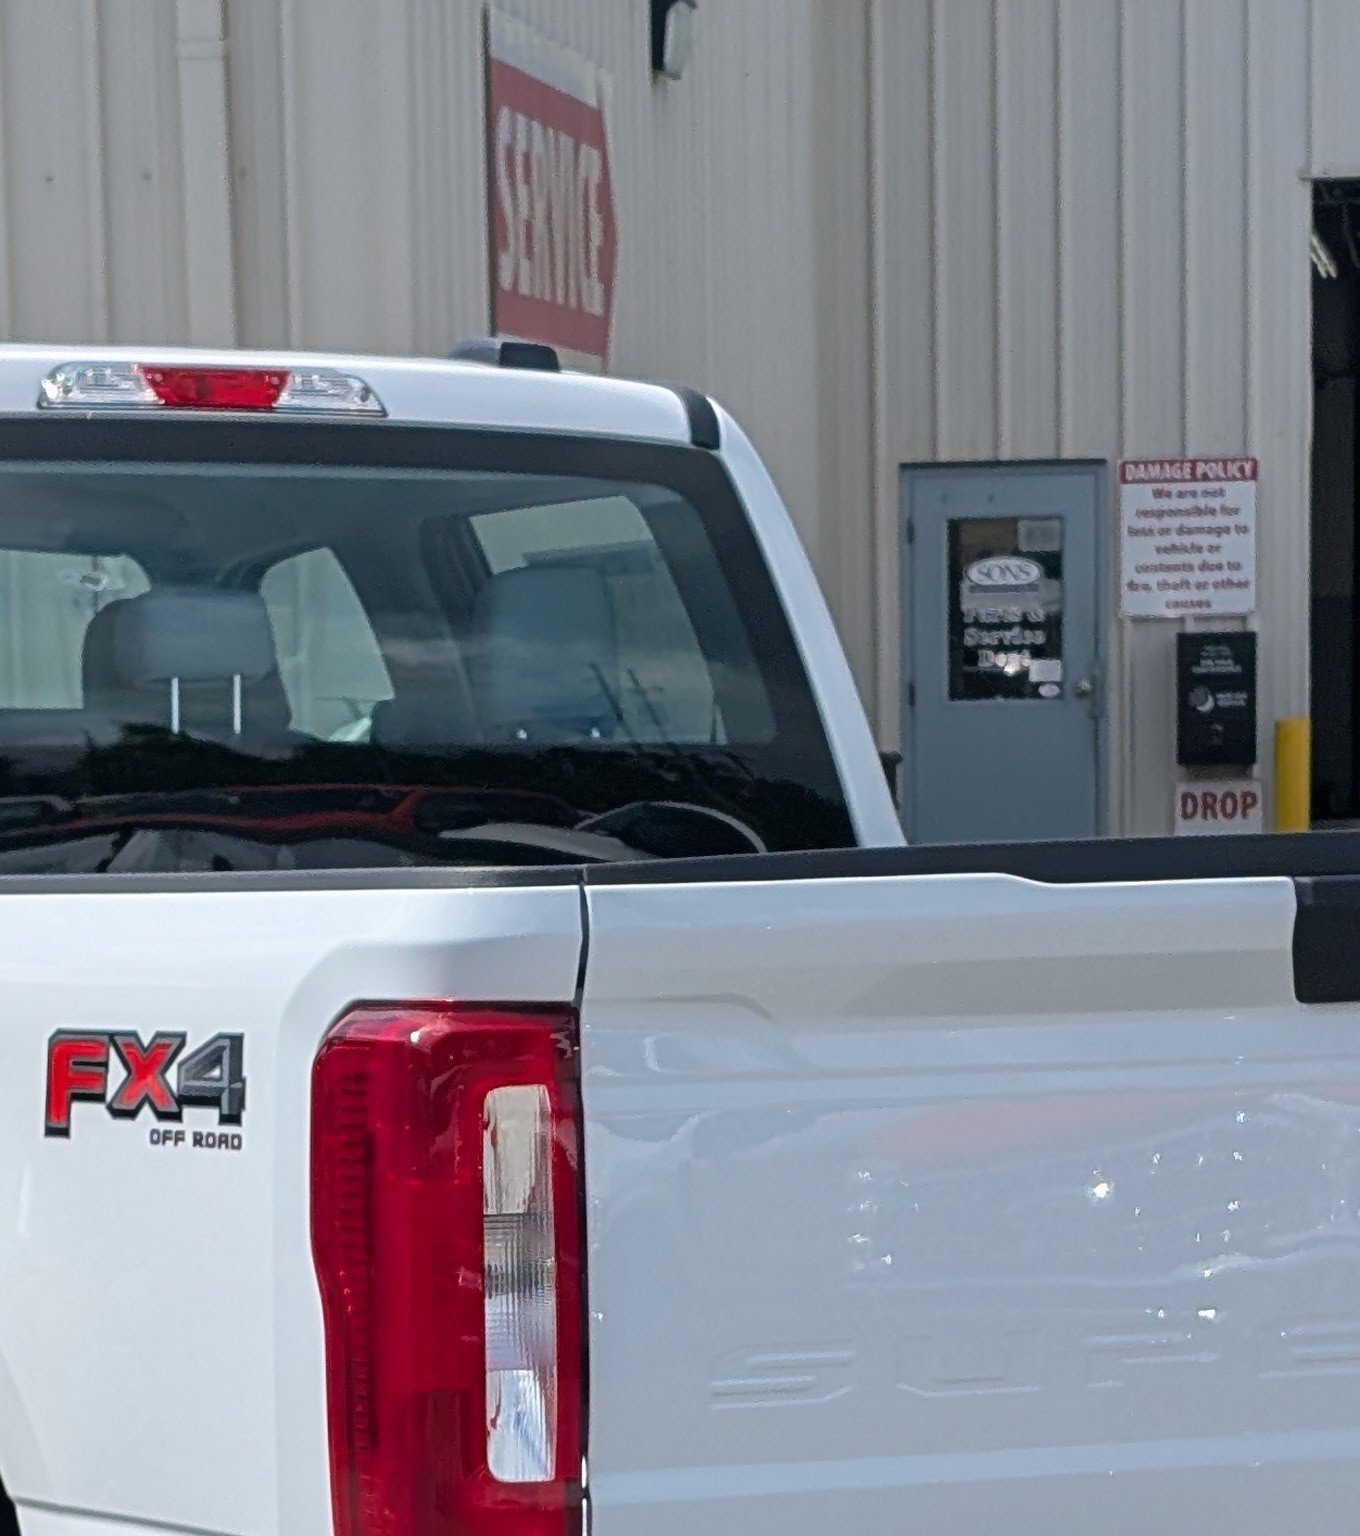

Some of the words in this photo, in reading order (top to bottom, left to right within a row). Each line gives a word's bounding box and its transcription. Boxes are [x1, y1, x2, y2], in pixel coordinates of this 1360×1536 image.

[497, 104, 604, 317] SERVICE
[1124, 462, 1192, 481] DAMAGE
[1195, 460, 1253, 479] POLICY
[1135, 505, 1217, 519] responsible
[1219, 504, 1240, 516] for
[1176, 523, 1231, 538] damage
[1154, 541, 1204, 555] vehicle
[1134, 561, 1195, 573] contents
[1156, 578, 1191, 591] theft
[1212, 577, 1250, 590] other
[963, 626, 1047, 646] Service
[1180, 791, 1258, 821] DROP
[44, 1028, 246, 1139] FX4
[149, 1129, 185, 1146] OFF
[192, 1131, 242, 1150] ROAD
